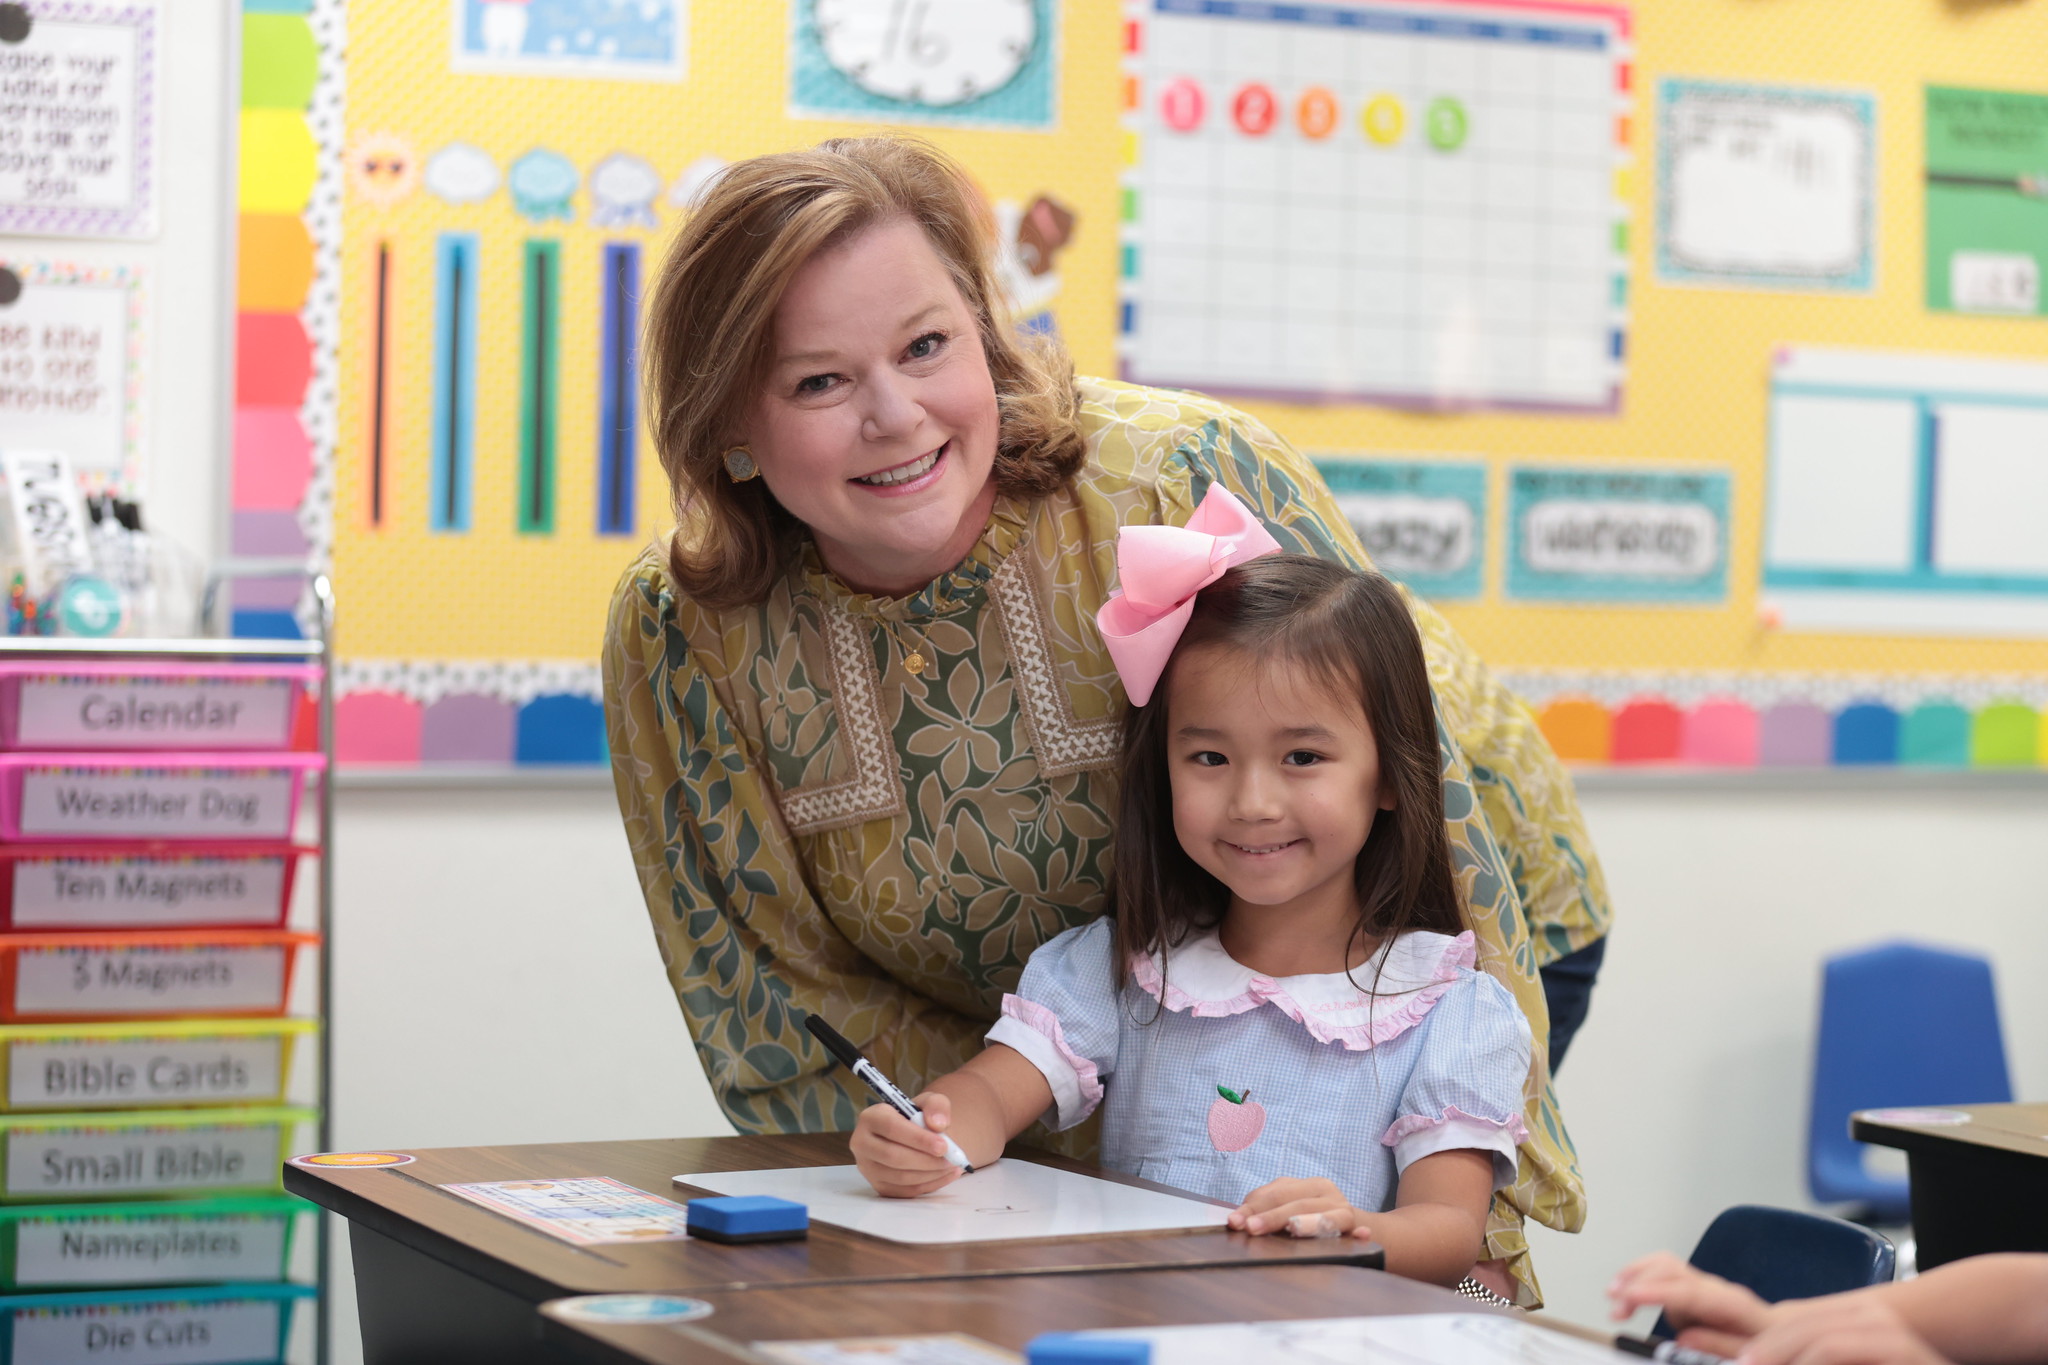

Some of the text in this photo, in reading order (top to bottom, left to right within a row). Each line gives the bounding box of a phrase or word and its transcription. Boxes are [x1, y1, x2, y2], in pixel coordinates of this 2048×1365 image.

[79, 693, 239, 731] Calendar
[56, 787, 260, 826] Weather Dog
[53, 868, 247, 907] Ten Magnets
[103, 960, 233, 996] Magnets
[44, 1055, 249, 1095] Bible Cards
[43, 1146, 244, 1184] Small Bible
[60, 1230, 243, 1262] Nameplates
[85, 1320, 212, 1353] Die Cuts
